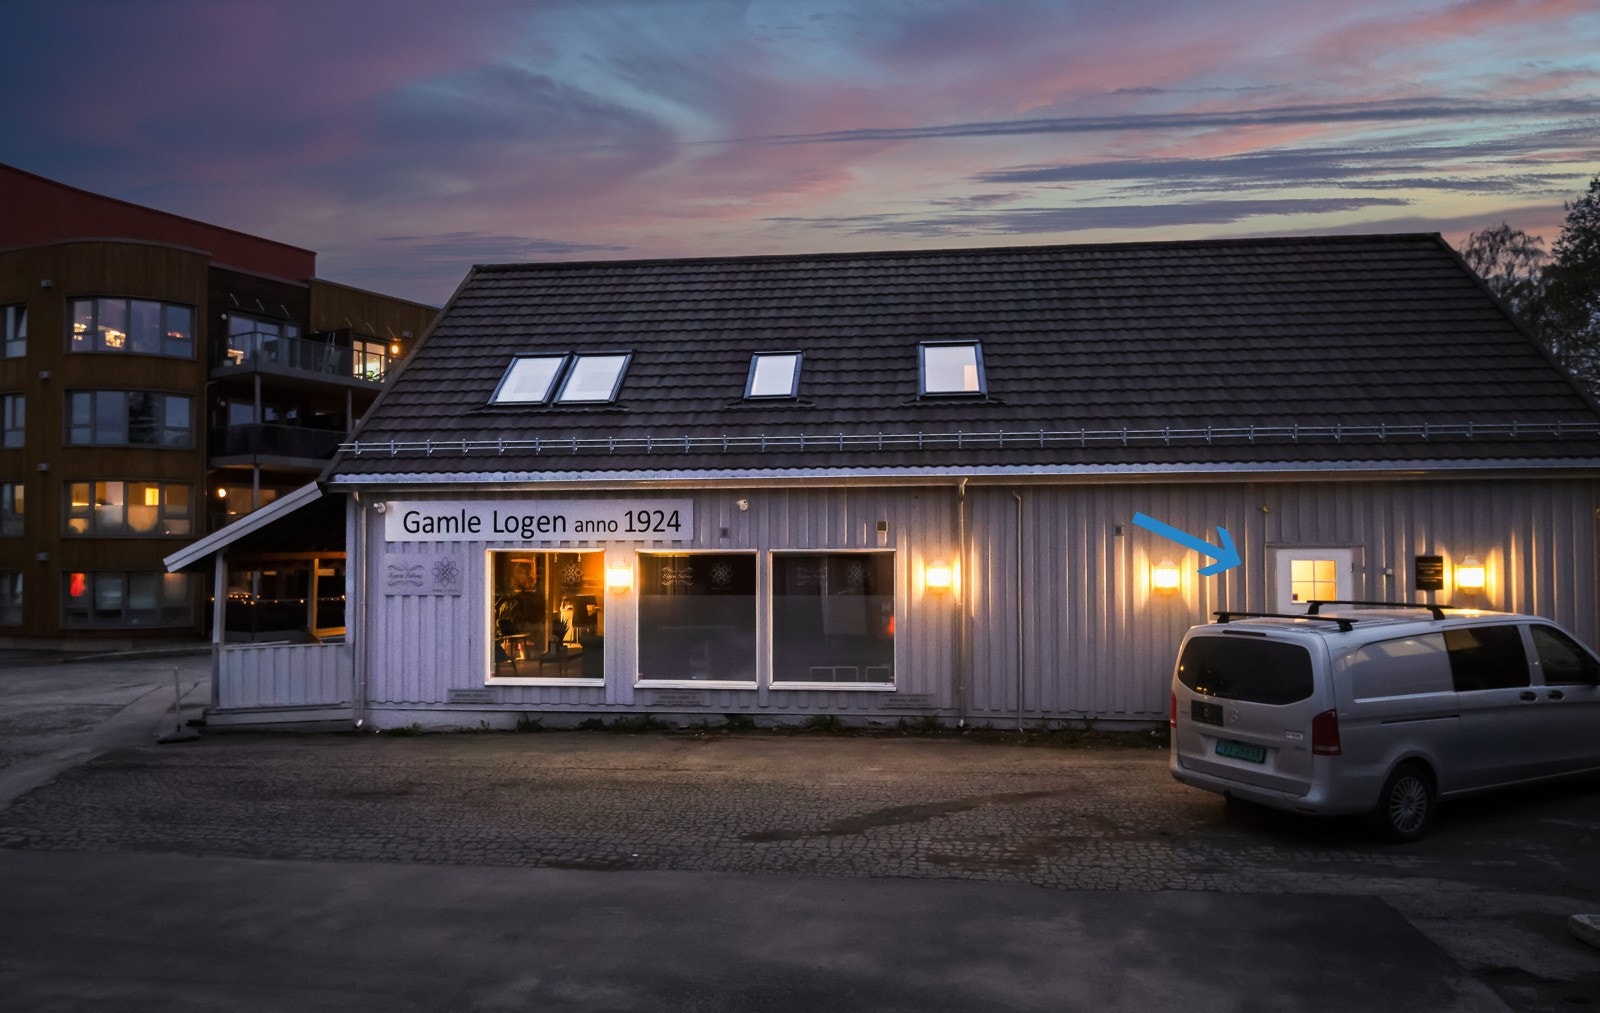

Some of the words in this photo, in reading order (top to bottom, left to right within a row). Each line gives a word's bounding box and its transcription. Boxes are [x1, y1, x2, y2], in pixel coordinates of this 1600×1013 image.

[403, 508, 482, 534] Gamle
[493, 510, 567, 539] Logen
[574, 518, 618, 533] anno
[624, 509, 682, 533] 1924
